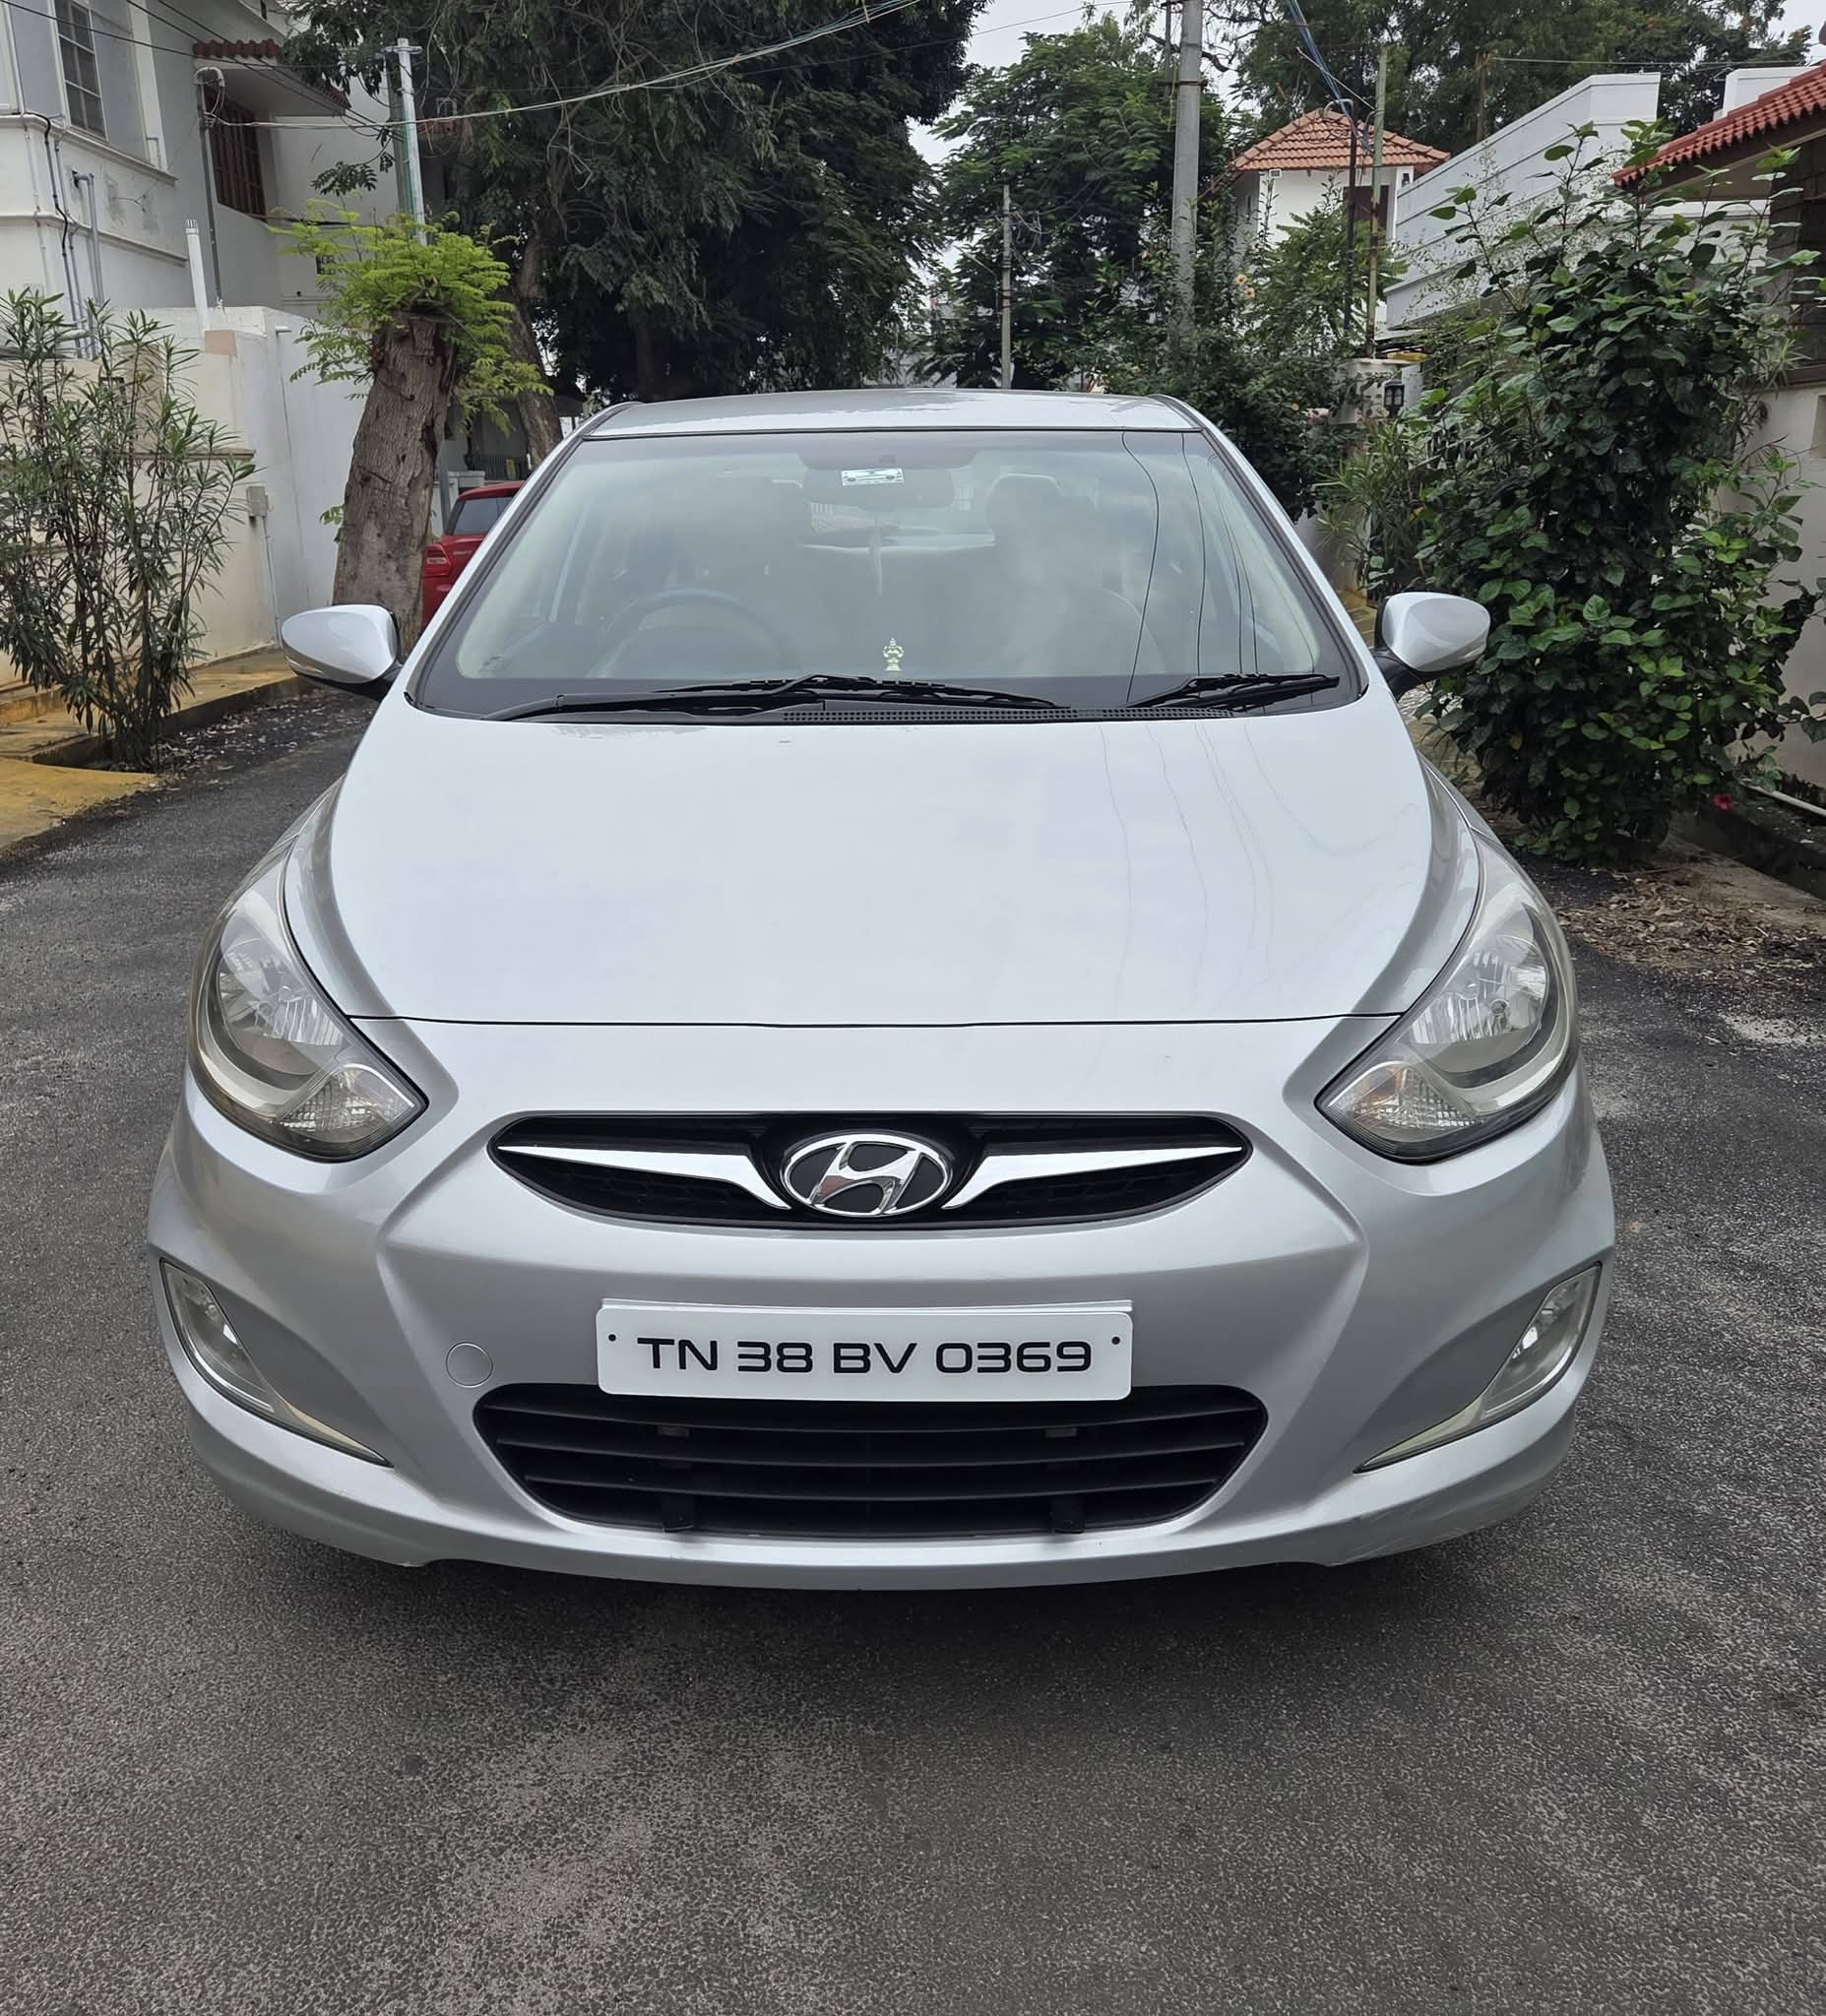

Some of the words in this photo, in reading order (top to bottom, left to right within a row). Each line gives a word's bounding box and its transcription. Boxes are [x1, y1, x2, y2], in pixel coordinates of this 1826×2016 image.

[637, 1337, 719, 1371] TN
[737, 1341, 813, 1373] 38
[833, 1342, 917, 1374] BV
[935, 1341, 1092, 1374] 0369
